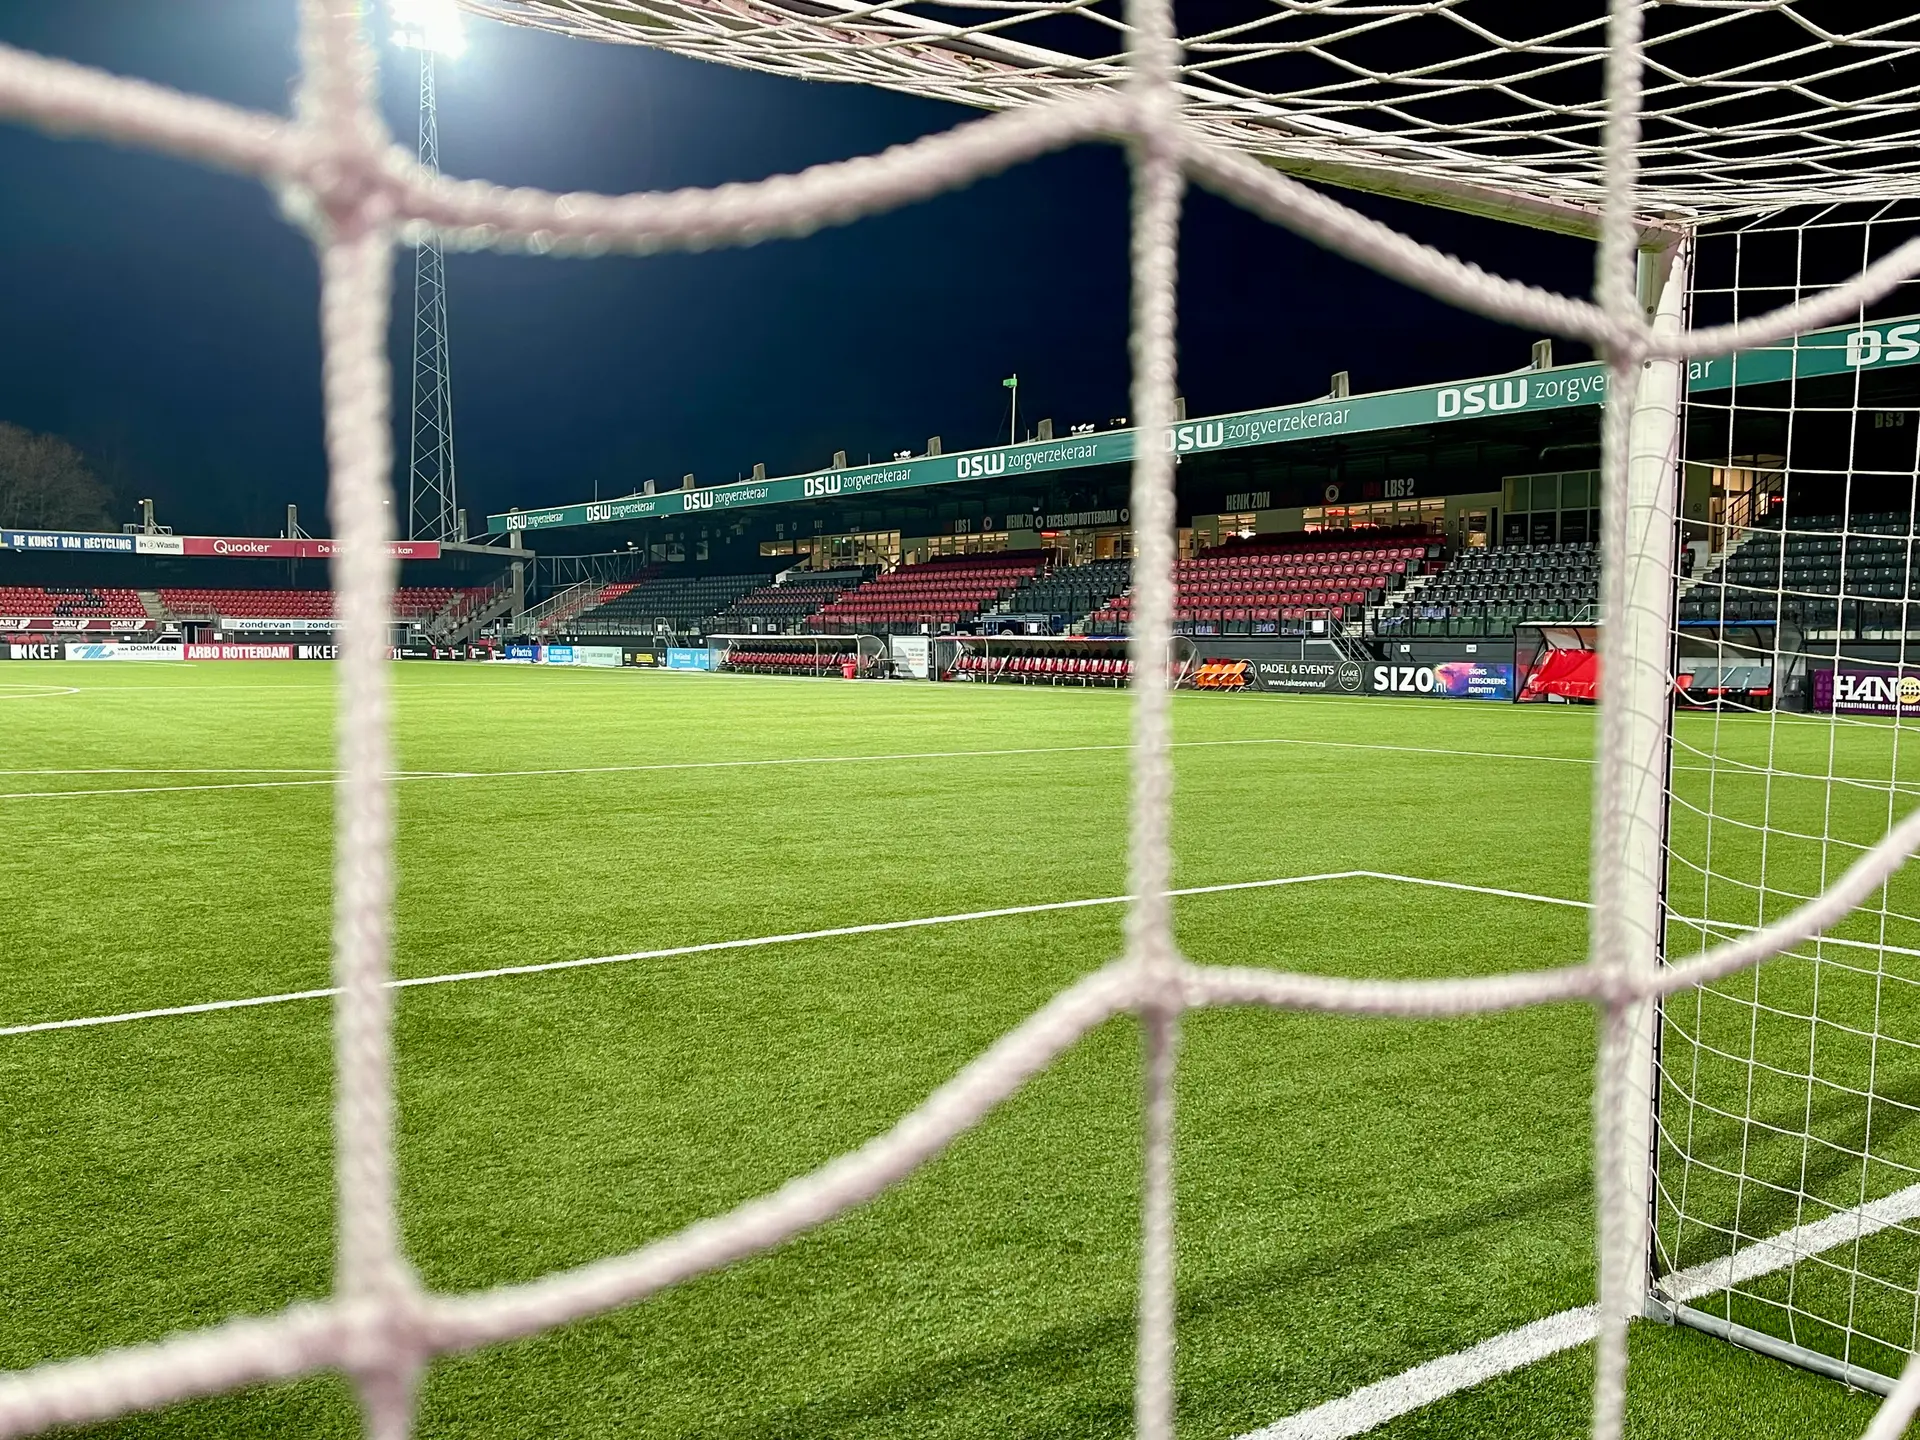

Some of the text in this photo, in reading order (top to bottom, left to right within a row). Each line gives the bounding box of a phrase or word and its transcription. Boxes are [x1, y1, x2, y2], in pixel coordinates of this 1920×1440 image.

[1847, 324, 1920, 366] DS
[1437, 379, 1528, 418] DSW
[1227, 409, 1351, 441] zorgverzekeraar
[957, 443, 1097, 478] DSW zorgverzekeraar
[804, 468, 911, 497] DSW zorgverzekeraar
[1384, 479, 1405, 498] LBS
[1406, 478, 1415, 496] 2
[683, 486, 769, 511] DSW zorgverzekeraar
[1226, 491, 1271, 511] HENK ZON
[586, 501, 656, 522] DSW zorgverzekeraar
[1046, 509, 1118, 528] EXCELSIOR ROTTERDAM
[507, 512, 564, 530] DSW zorgverzekeraar
[13, 535, 25, 546] DE
[28, 536, 59, 548] KUNST
[61, 536, 81, 548] VAN
[84, 538, 132, 550] RECYCLING
[213, 539, 270, 554] Quooker
[318, 545, 330, 553] De
[110, 619, 133, 627] CARU
[239, 621, 291, 629] zondervan
[188, 646, 290, 659] ARBO ROTTERDAM
[1260, 664, 1290, 673] PADEL
[1290, 664, 1298, 673] &
[1299, 665, 1335, 675] EVENTS
[1341, 669, 1359, 677] LAKE
[1267, 679, 1327, 688] www.lakeseven.nl
[1468, 678, 1507, 686] LEDSCREENS
